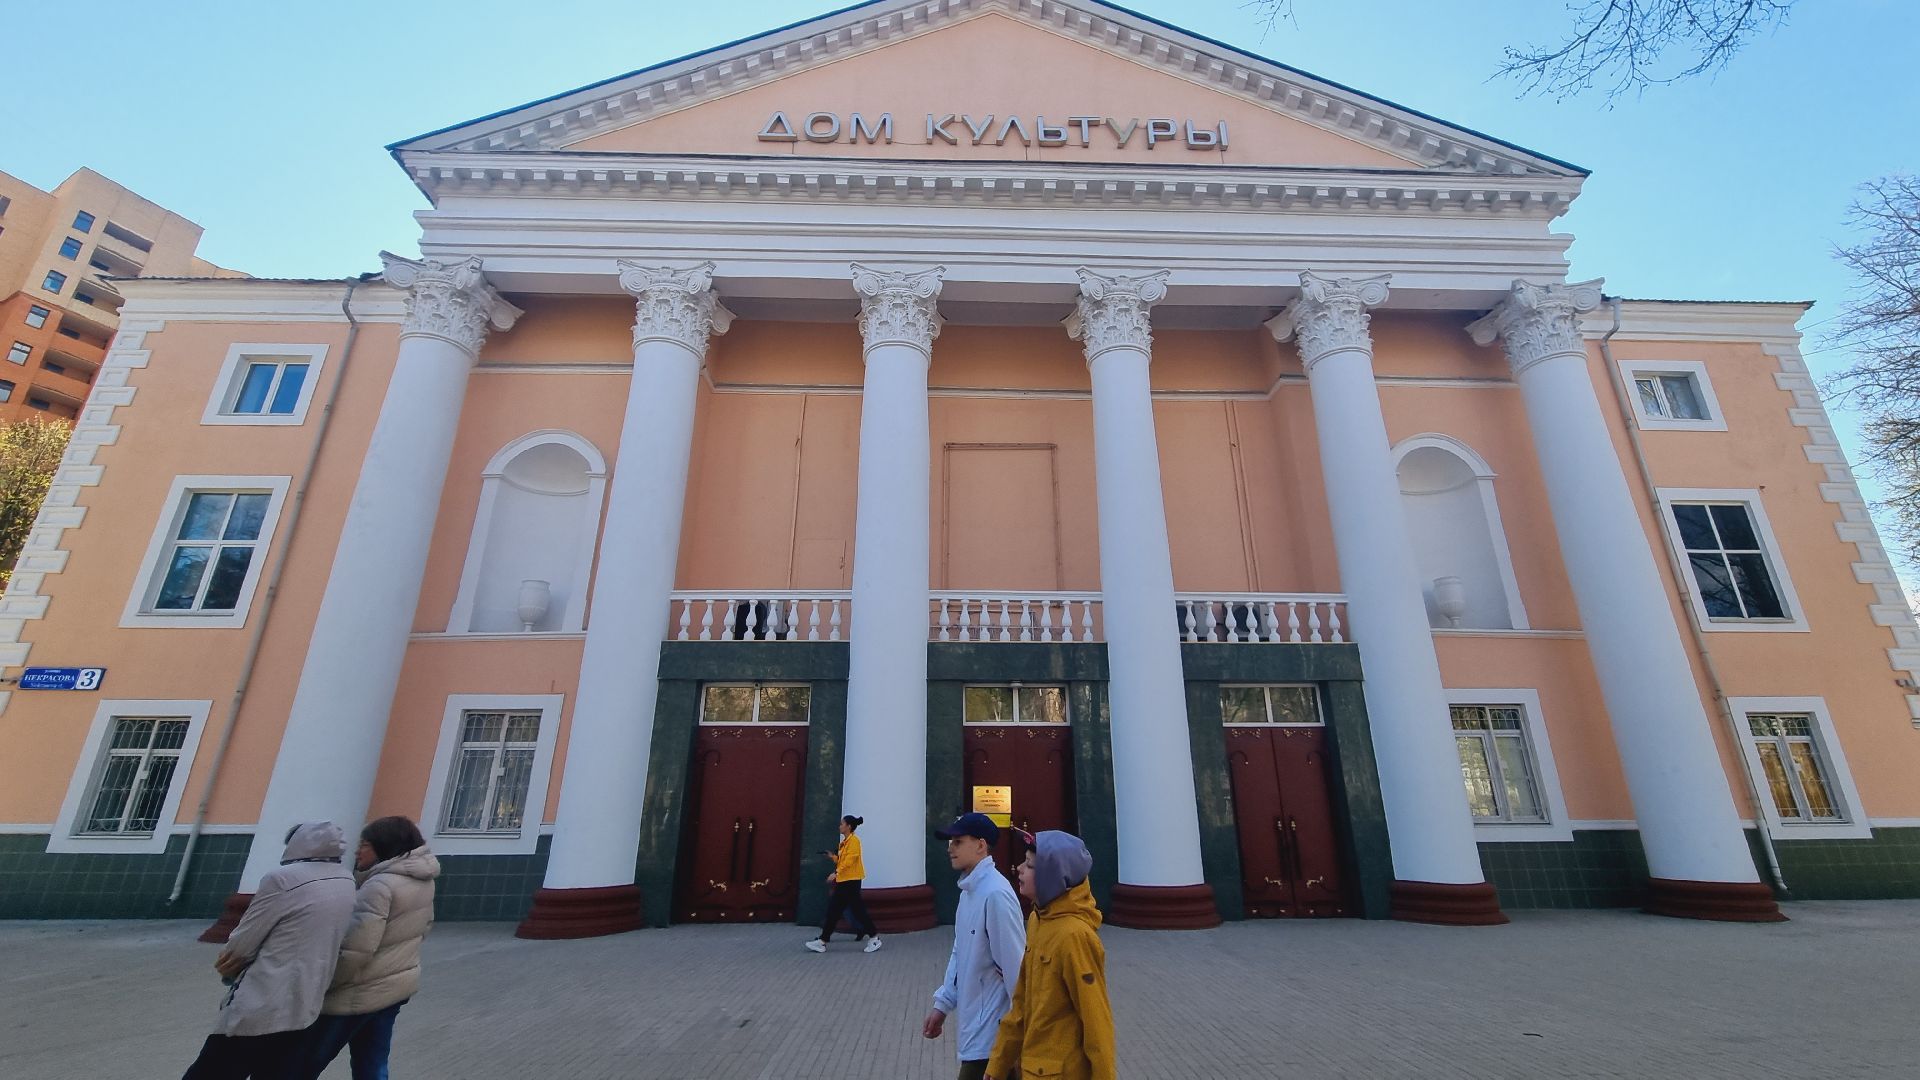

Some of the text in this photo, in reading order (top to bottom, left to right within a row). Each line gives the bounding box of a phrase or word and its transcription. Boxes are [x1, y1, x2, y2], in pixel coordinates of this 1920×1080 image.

[758, 111, 1228, 152] ДОМ КУЛЬТУРЫ
[24, 674, 75, 682] НЕКРАСОВА
[80, 670, 96, 687] 3
